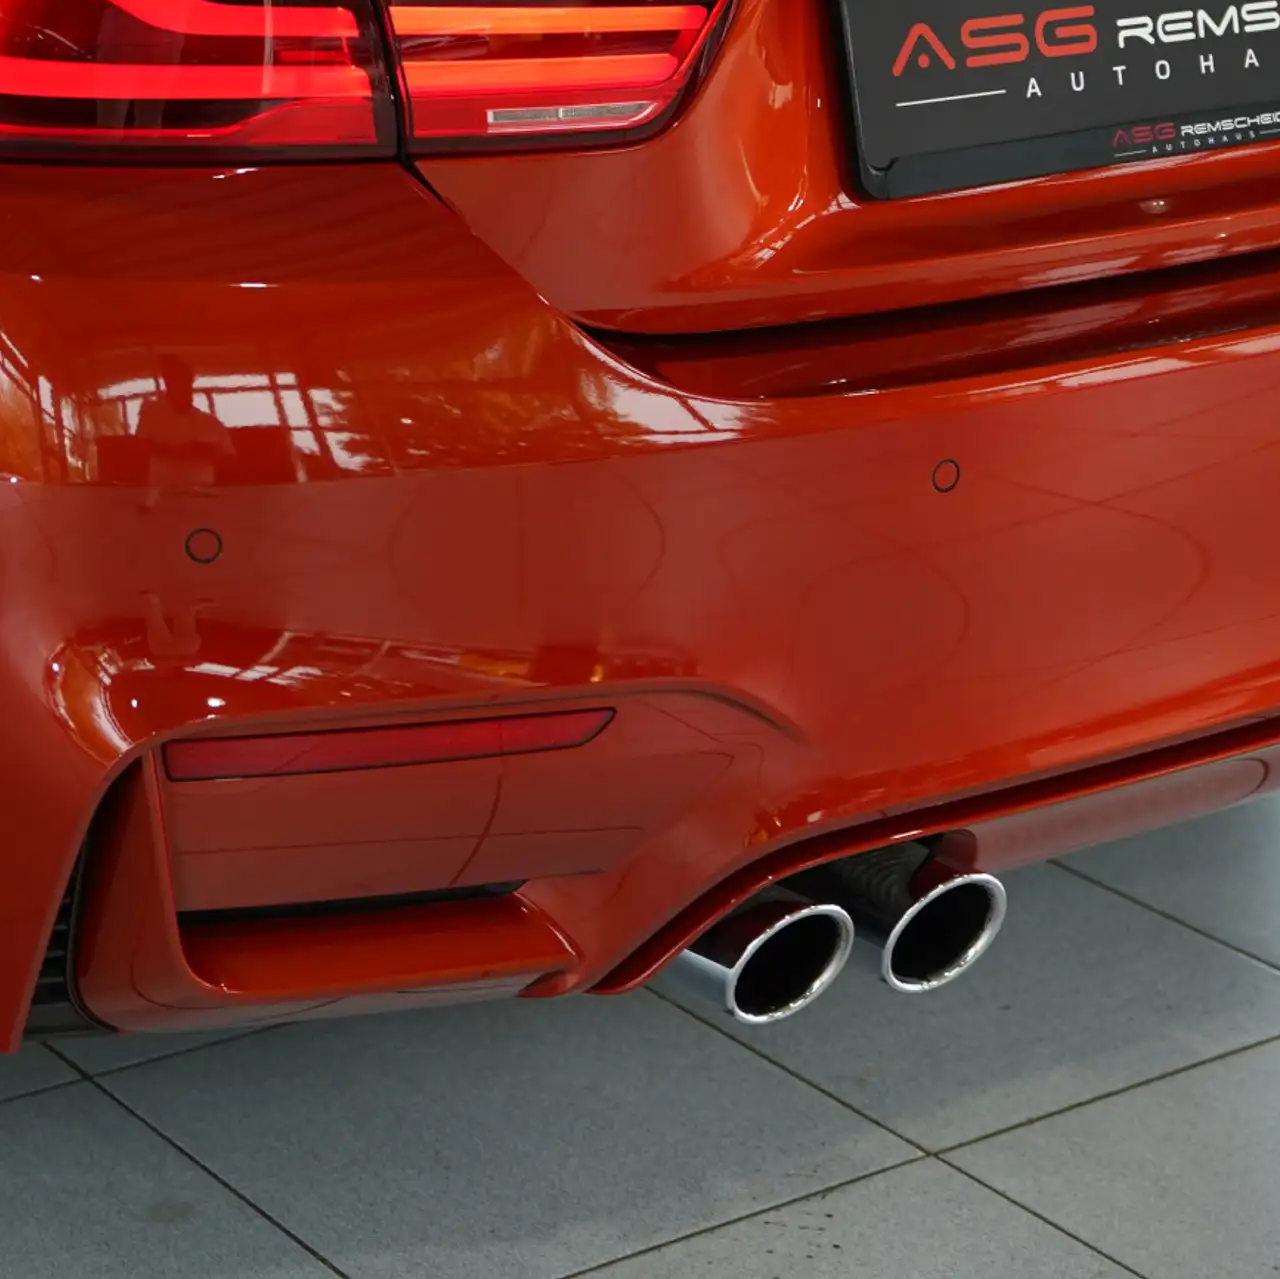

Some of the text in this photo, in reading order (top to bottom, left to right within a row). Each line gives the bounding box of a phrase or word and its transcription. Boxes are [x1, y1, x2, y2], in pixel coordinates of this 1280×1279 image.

[892, 5, 1098, 77] ASG
[1113, 122, 1177, 148] ASG
[1152, 130, 1256, 154] AUTOHAUS
